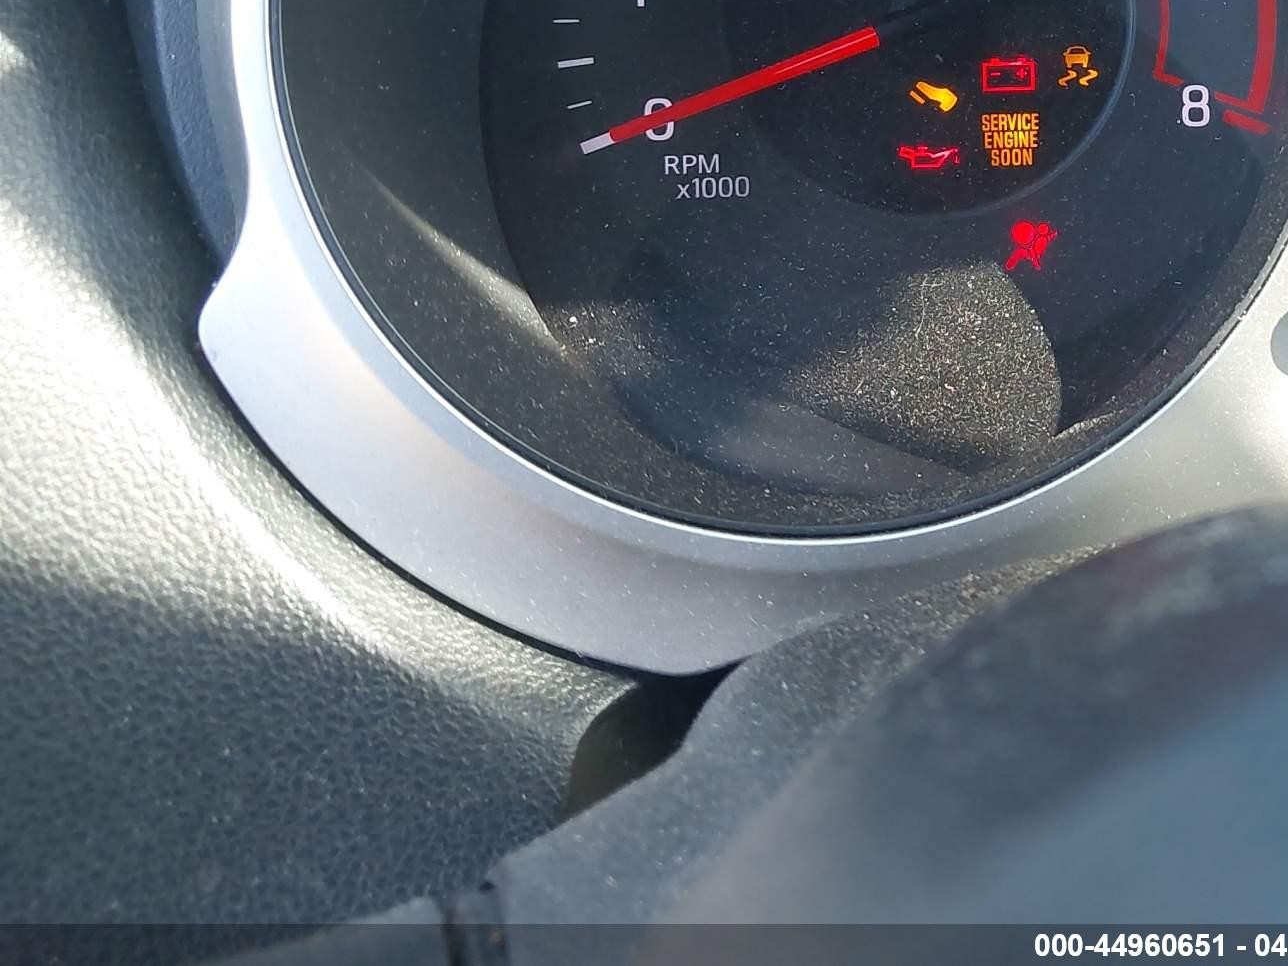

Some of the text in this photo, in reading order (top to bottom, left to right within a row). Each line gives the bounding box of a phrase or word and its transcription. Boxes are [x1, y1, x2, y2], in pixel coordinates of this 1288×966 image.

[1182, 85, 1209, 126] 8
[981, 113, 1039, 131] SERVICE
[984, 131, 1038, 149] ENGINE
[665, 154, 719, 178] RPM
[991, 148, 1033, 166] SOON
[678, 177, 749, 198] x1000
